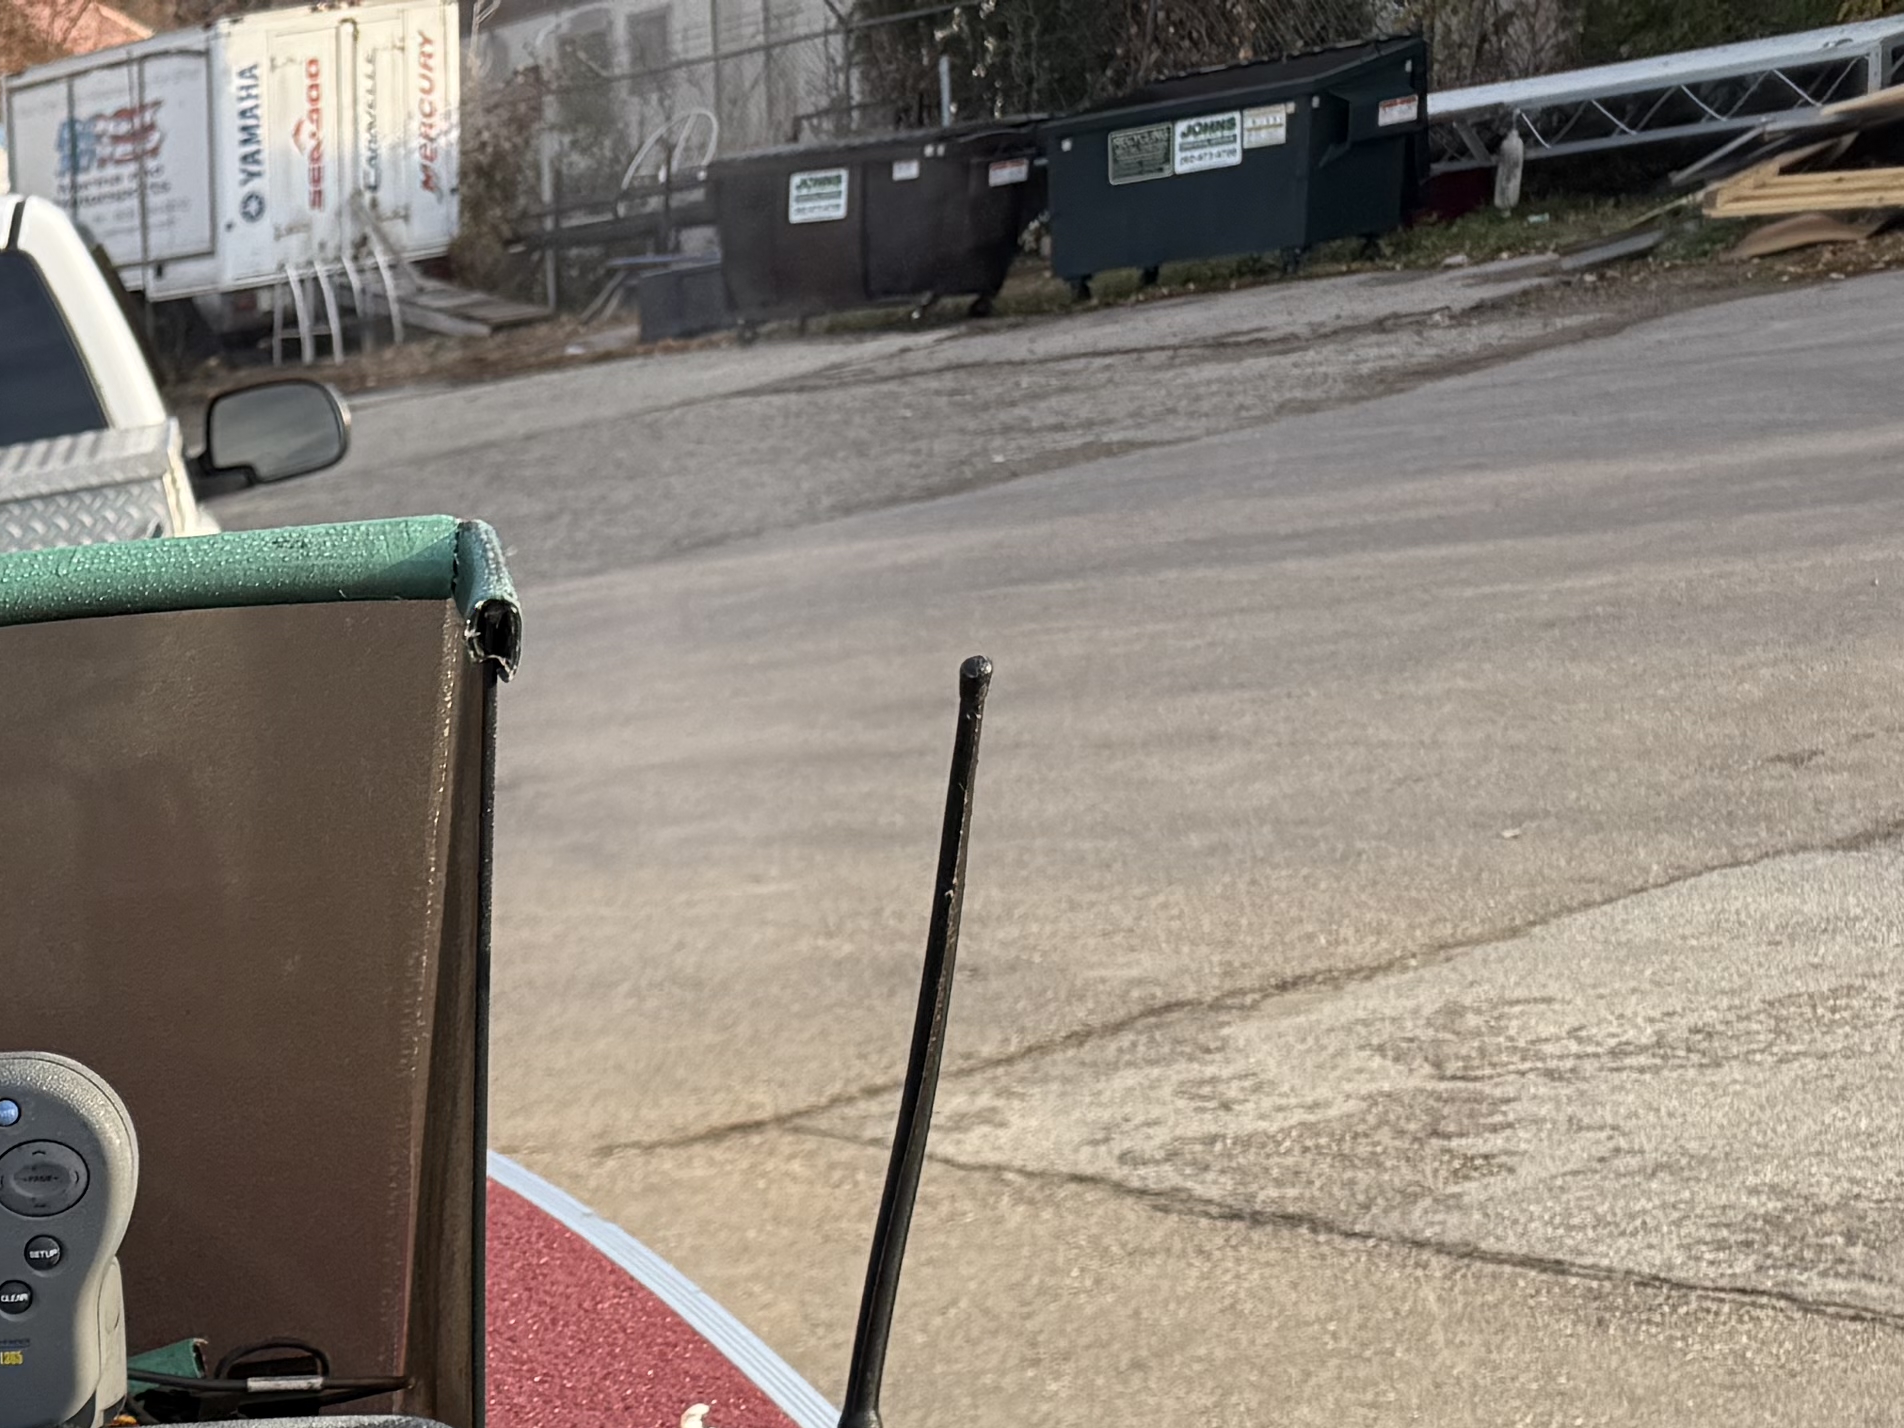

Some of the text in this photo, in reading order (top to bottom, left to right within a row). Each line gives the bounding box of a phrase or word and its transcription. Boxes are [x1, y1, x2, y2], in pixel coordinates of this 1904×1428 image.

[418, 29, 439, 194] MERCURY
[236, 63, 264, 187] YAMAHA
[1180, 116, 1237, 139] JOHNS
[29, 1248, 59, 1259] SETUP
[0, 1293, 29, 1302] CLEAR
